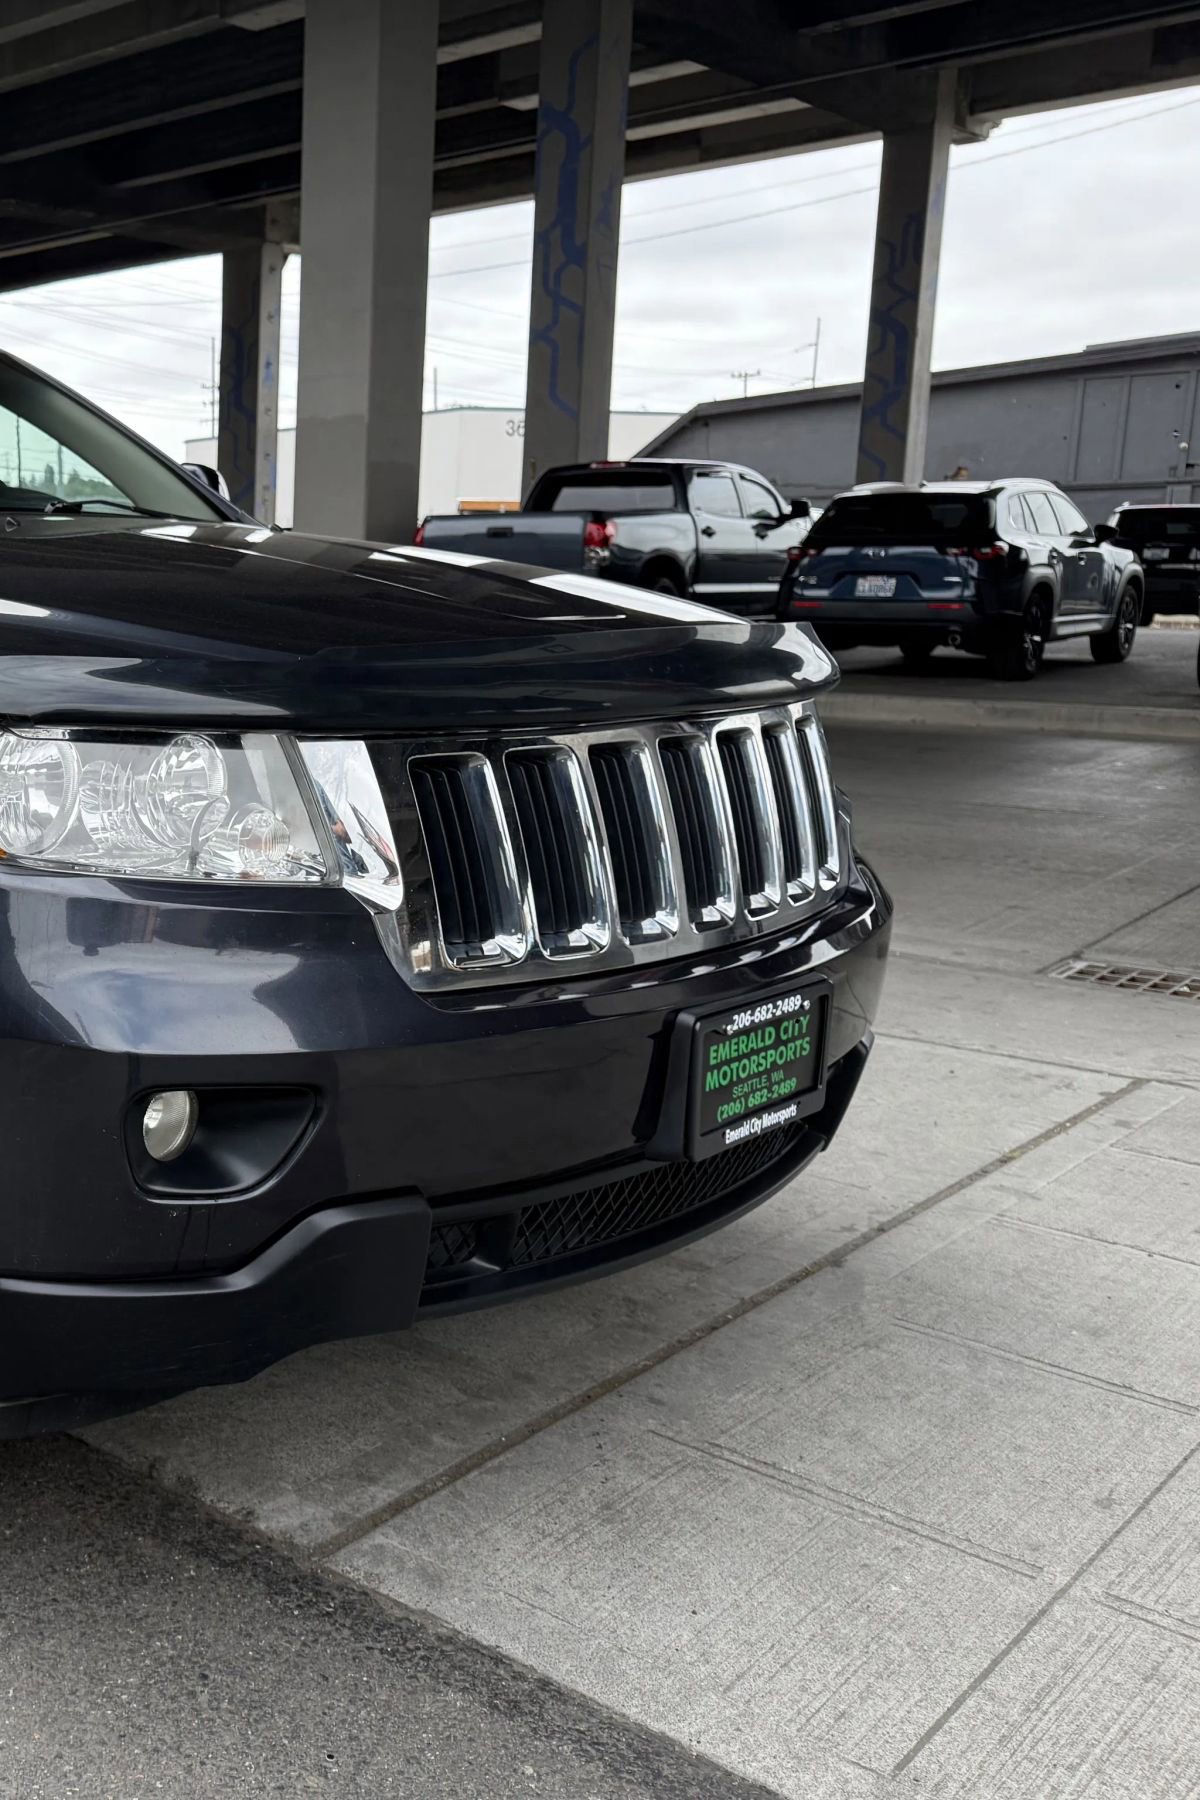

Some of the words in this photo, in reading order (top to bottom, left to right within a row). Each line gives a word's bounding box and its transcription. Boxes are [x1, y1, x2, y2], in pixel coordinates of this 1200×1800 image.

[733, 995, 801, 1029] 206-682-2489
[710, 1026, 775, 1066] EMERALD
[780, 1016, 810, 1040] CITY
[706, 1038, 810, 1091] MOTORSPORTS
[771, 1069, 785, 1086] WA
[717, 1096, 745, 1123] (206)
[748, 1078, 796, 1108] 682-2489
[725, 1118, 750, 1145] Emerald
[749, 1113, 763, 1136] City
[762, 1103, 797, 1130] Motorsports
